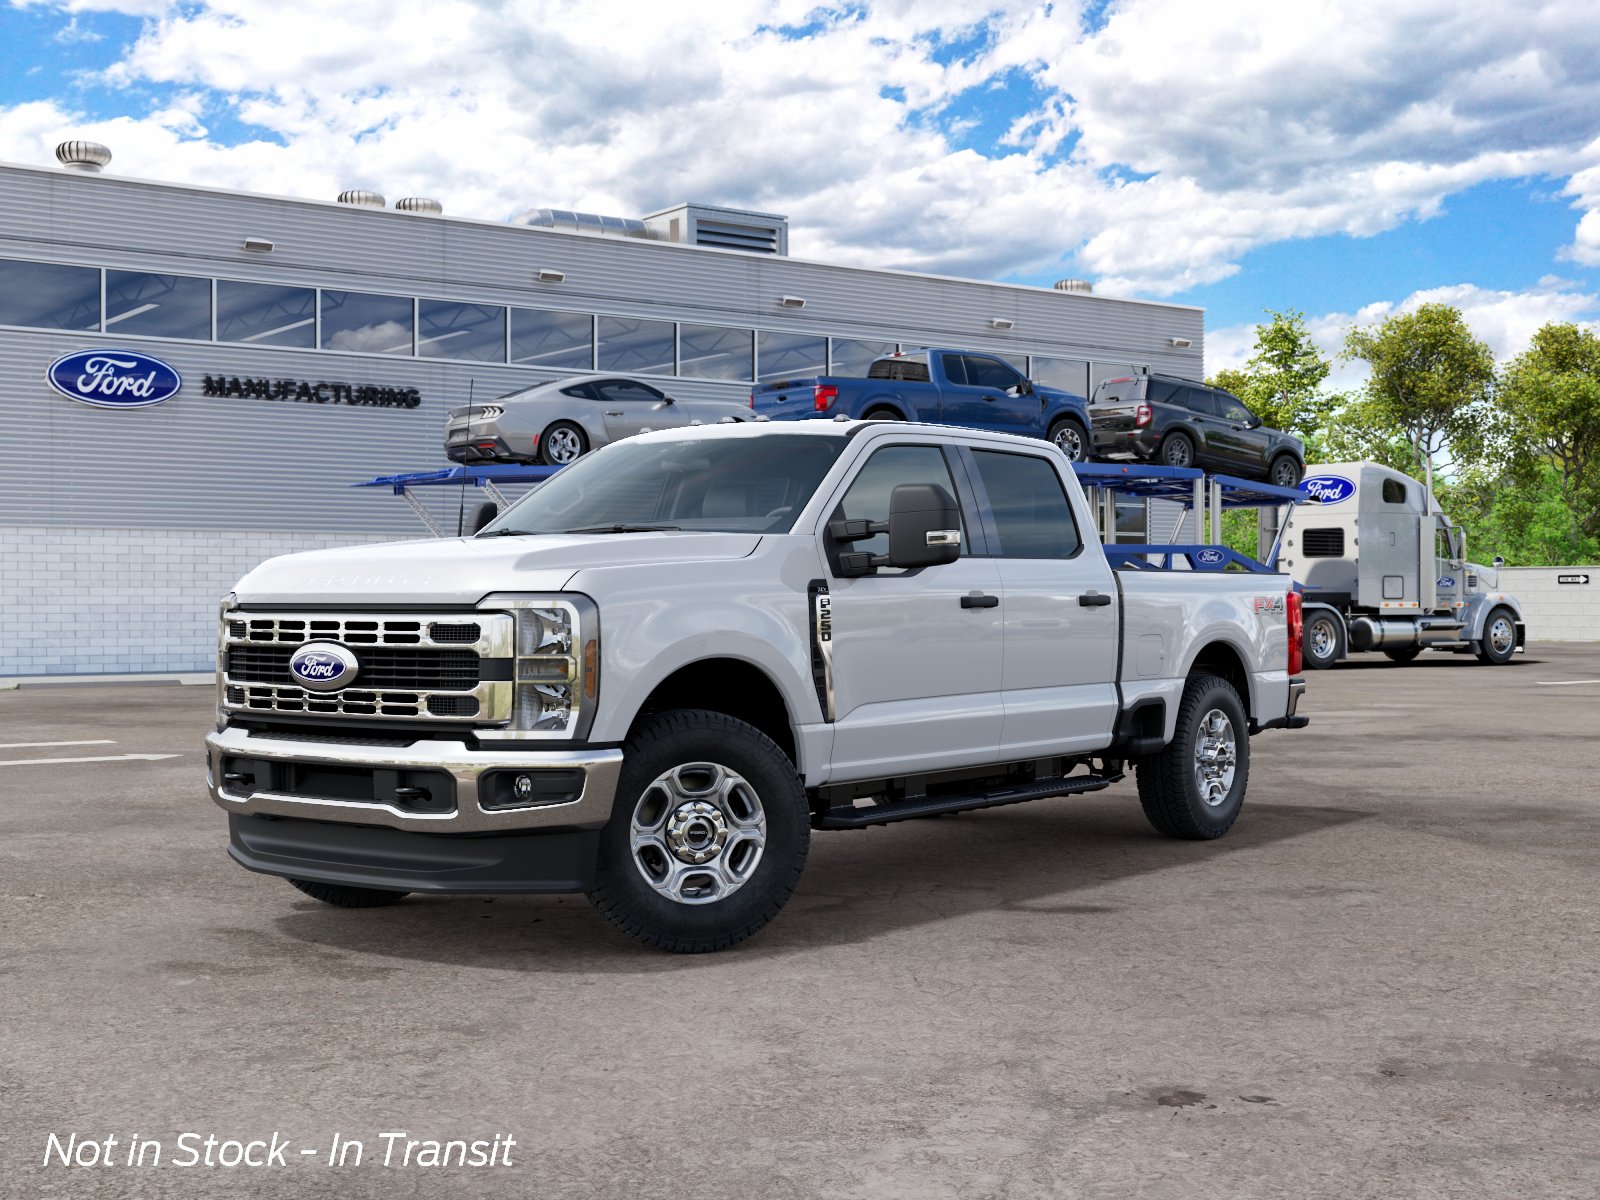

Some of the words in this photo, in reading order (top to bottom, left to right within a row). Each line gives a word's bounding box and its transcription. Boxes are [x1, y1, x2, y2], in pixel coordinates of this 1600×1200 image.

[77, 357, 156, 397] Ford
[203, 374, 421, 408] MANUFACTURING
[1305, 480, 1342, 500] Ford
[1254, 597, 1283, 614] FX4
[301, 655, 335, 676] Ford
